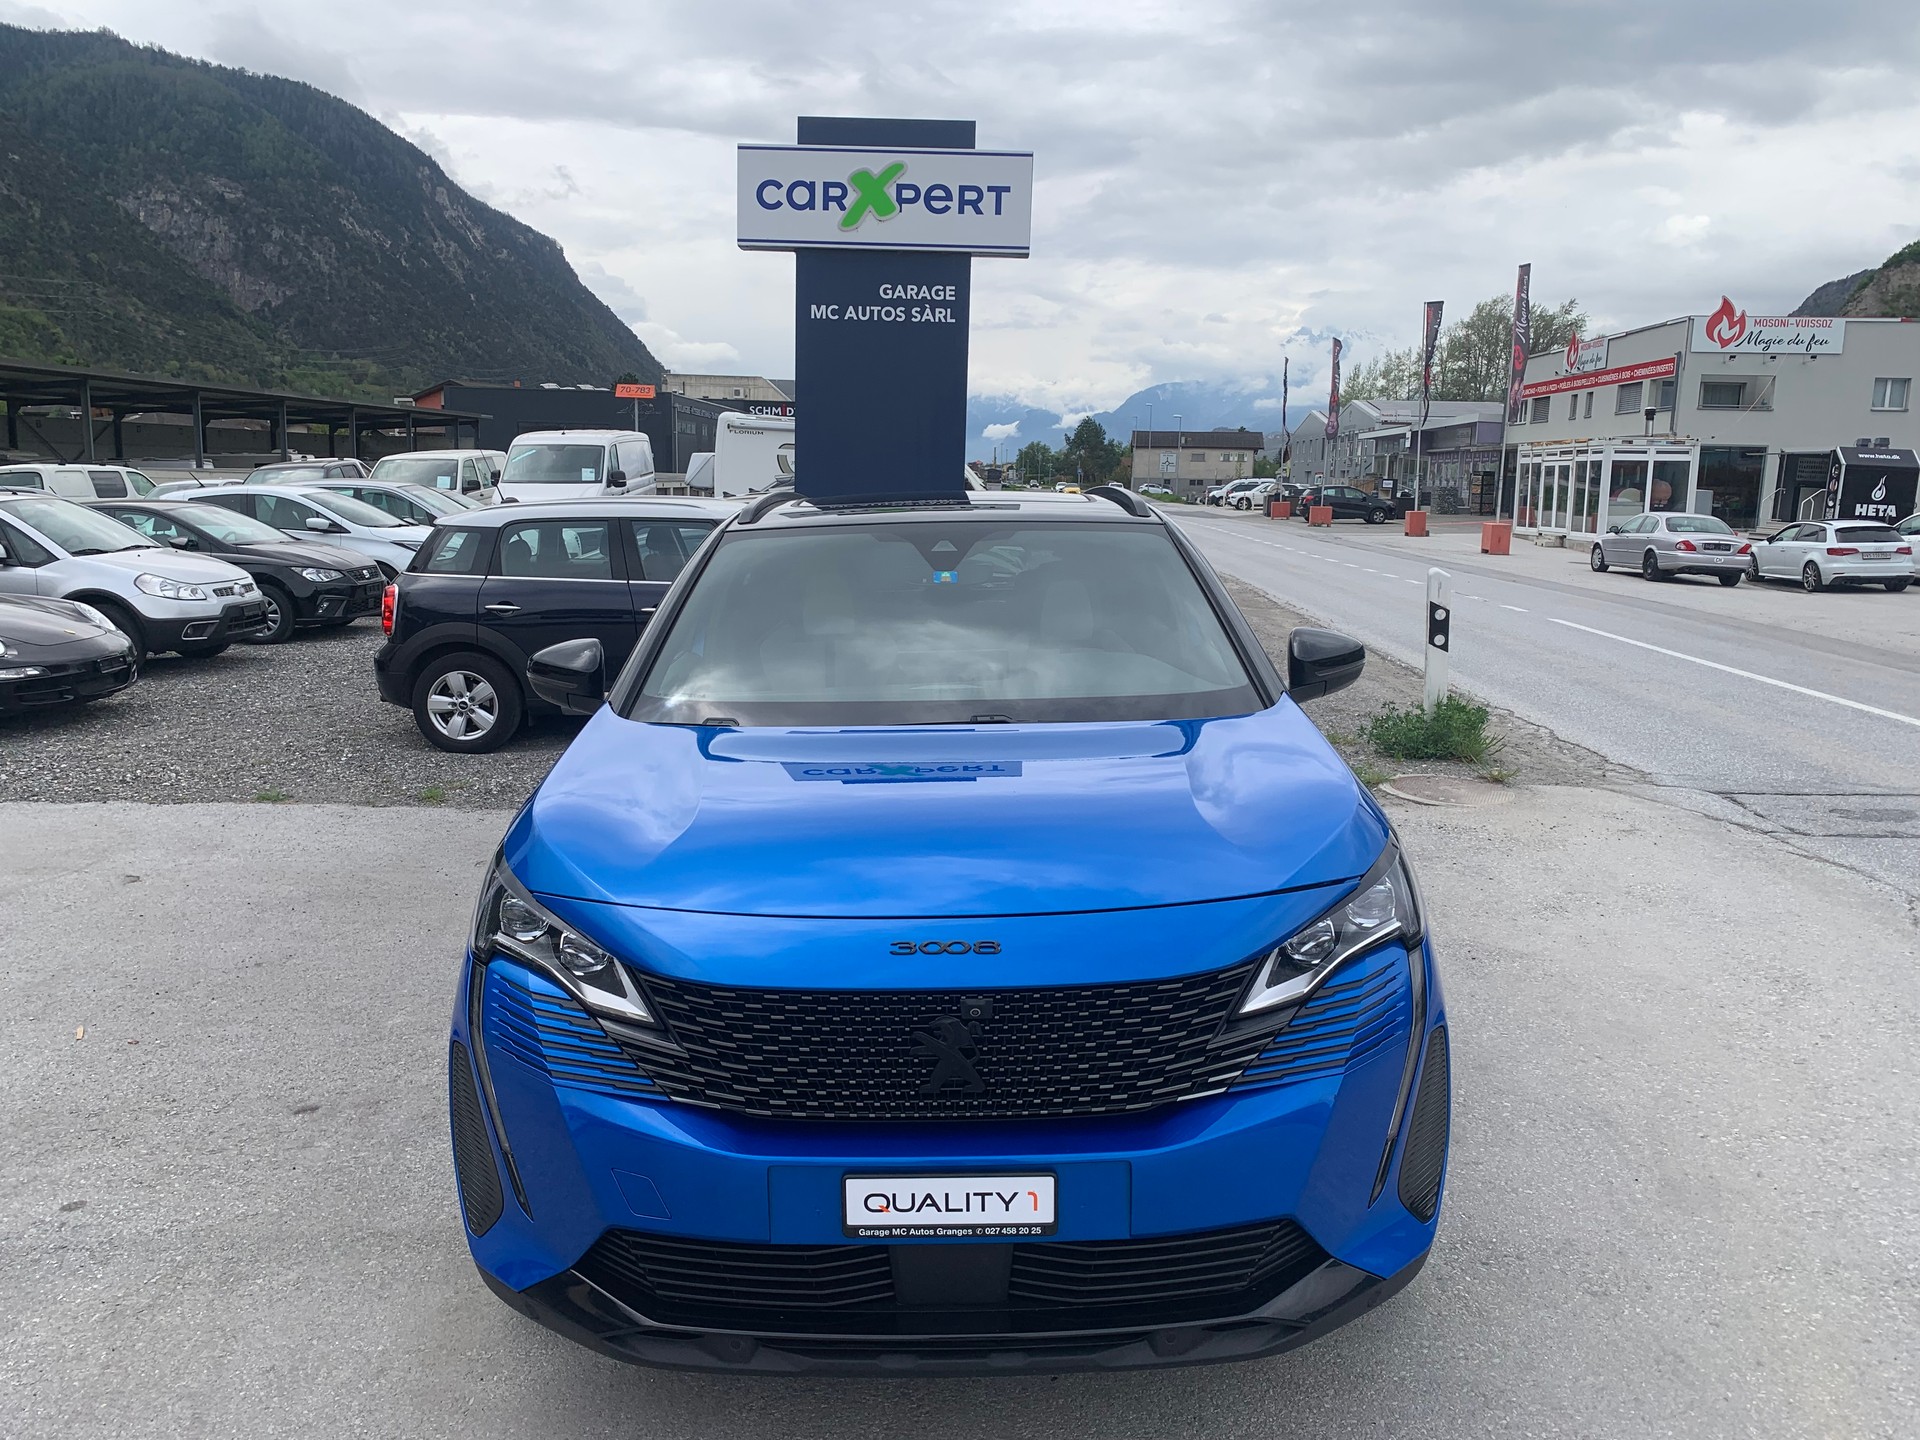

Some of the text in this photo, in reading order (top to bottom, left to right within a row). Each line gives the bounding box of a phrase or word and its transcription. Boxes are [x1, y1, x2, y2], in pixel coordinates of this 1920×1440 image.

[879, 284, 956, 301] GARAGE
[810, 305, 839, 320] MC
[844, 306, 906, 322] AUTOS
[1753, 318, 1833, 328] MOSONI-VUISSOZ
[1734, 330, 1830, 352] Magie du feu
[620, 386, 651, 394] 70-783
[1855, 503, 1897, 517] HETA
[890, 940, 1002, 956] 3008
[863, 1190, 1038, 1213] QUALITY 1
[858, 1226, 1042, 1237] Garage MC Autos Granges 027 458 20 25
